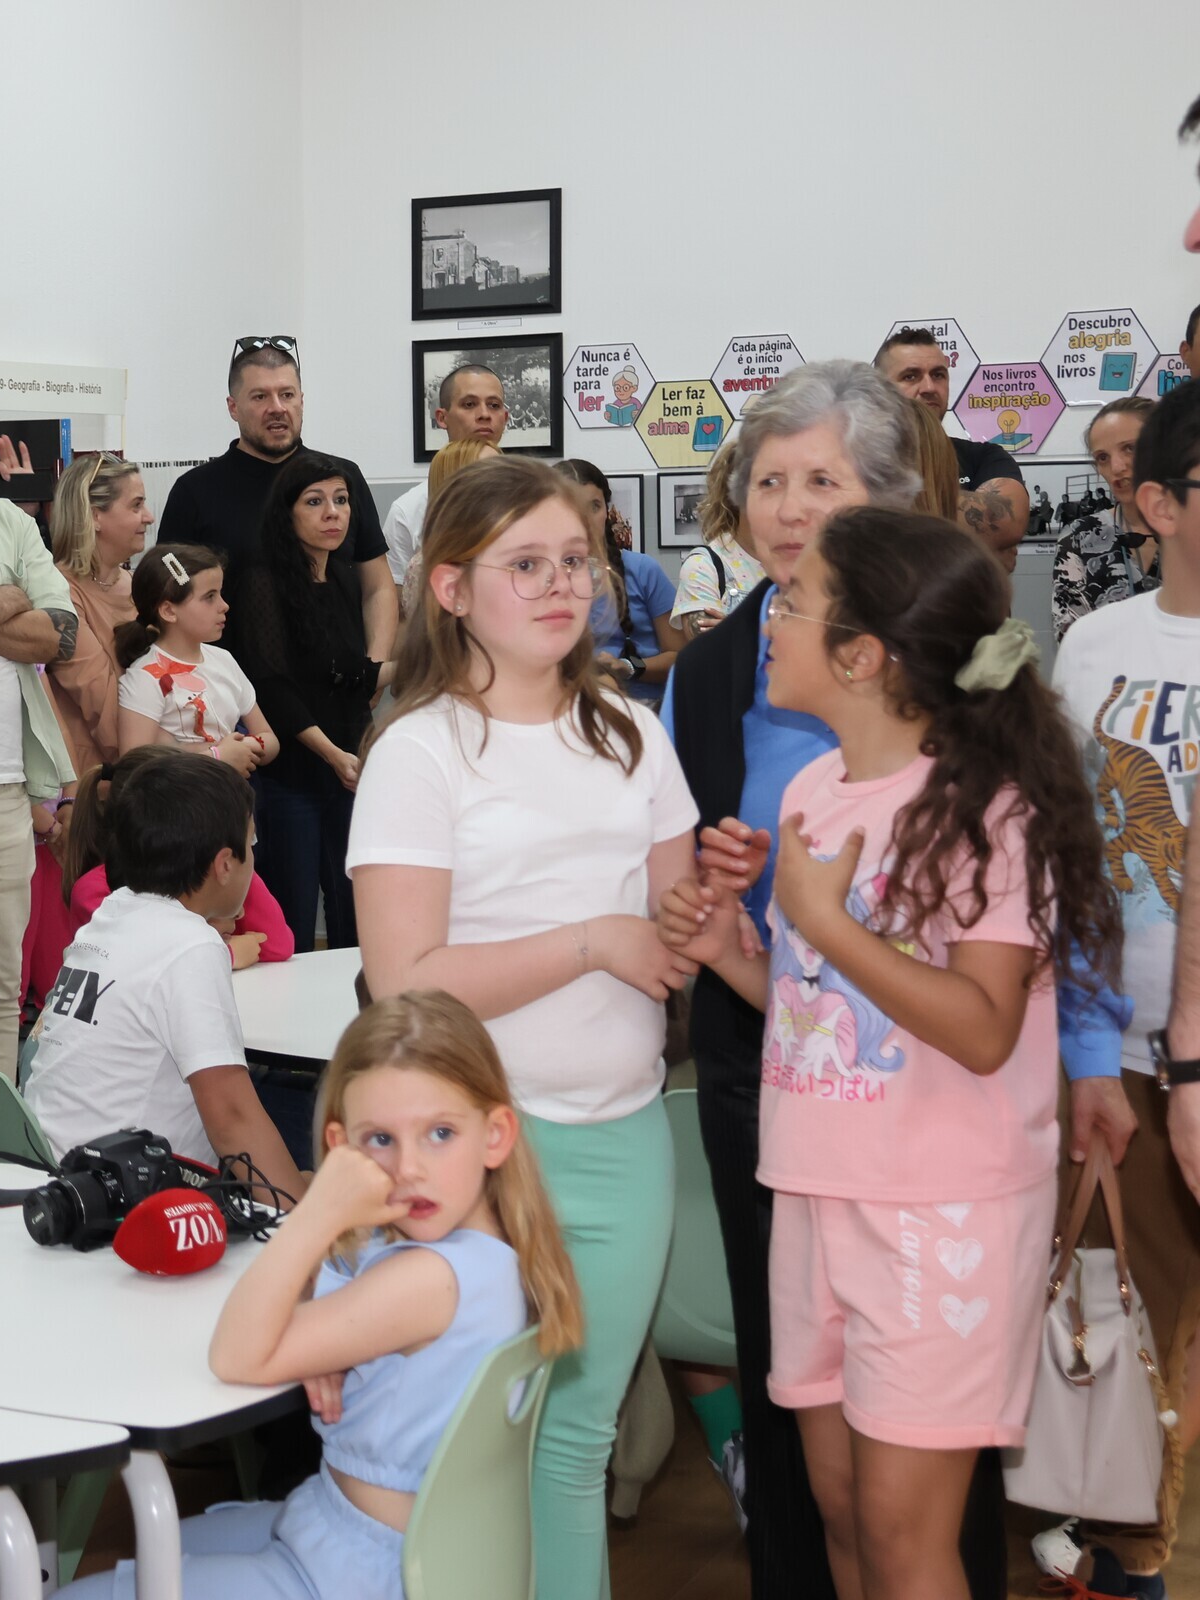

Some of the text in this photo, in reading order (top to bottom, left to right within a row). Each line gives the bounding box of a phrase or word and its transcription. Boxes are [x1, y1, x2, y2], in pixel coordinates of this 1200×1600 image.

[1069, 315, 1131, 330] Descubro
[931, 323, 948, 336] tal
[732, 340, 791, 353] Cada página
[1069, 330, 1131, 351] alegria
[582, 348, 630, 362] Nunca é
[738, 355, 743, 364] é
[756, 352, 782, 363] início
[1064, 353, 1085, 363] nos
[576, 364, 609, 377] tarde
[744, 366, 755, 375] de
[983, 368, 1036, 380] Nos livros
[1057, 365, 1096, 378] livros
[8, 379, 40, 393] Geografia
[46, 381, 74, 395] Biografia
[574, 380, 601, 393] para
[984, 381, 1035, 393] encontro
[662, 387, 705, 400] Ler faz
[578, 392, 604, 411] ler
[968, 391, 1050, 411] inspiração
[663, 404, 692, 417] bem
[648, 418, 689, 436] alma
[32, 1212, 45, 1225] Canon
[169, 1212, 224, 1252] VOZ
[898, 1209, 930, 1330] L'amour
